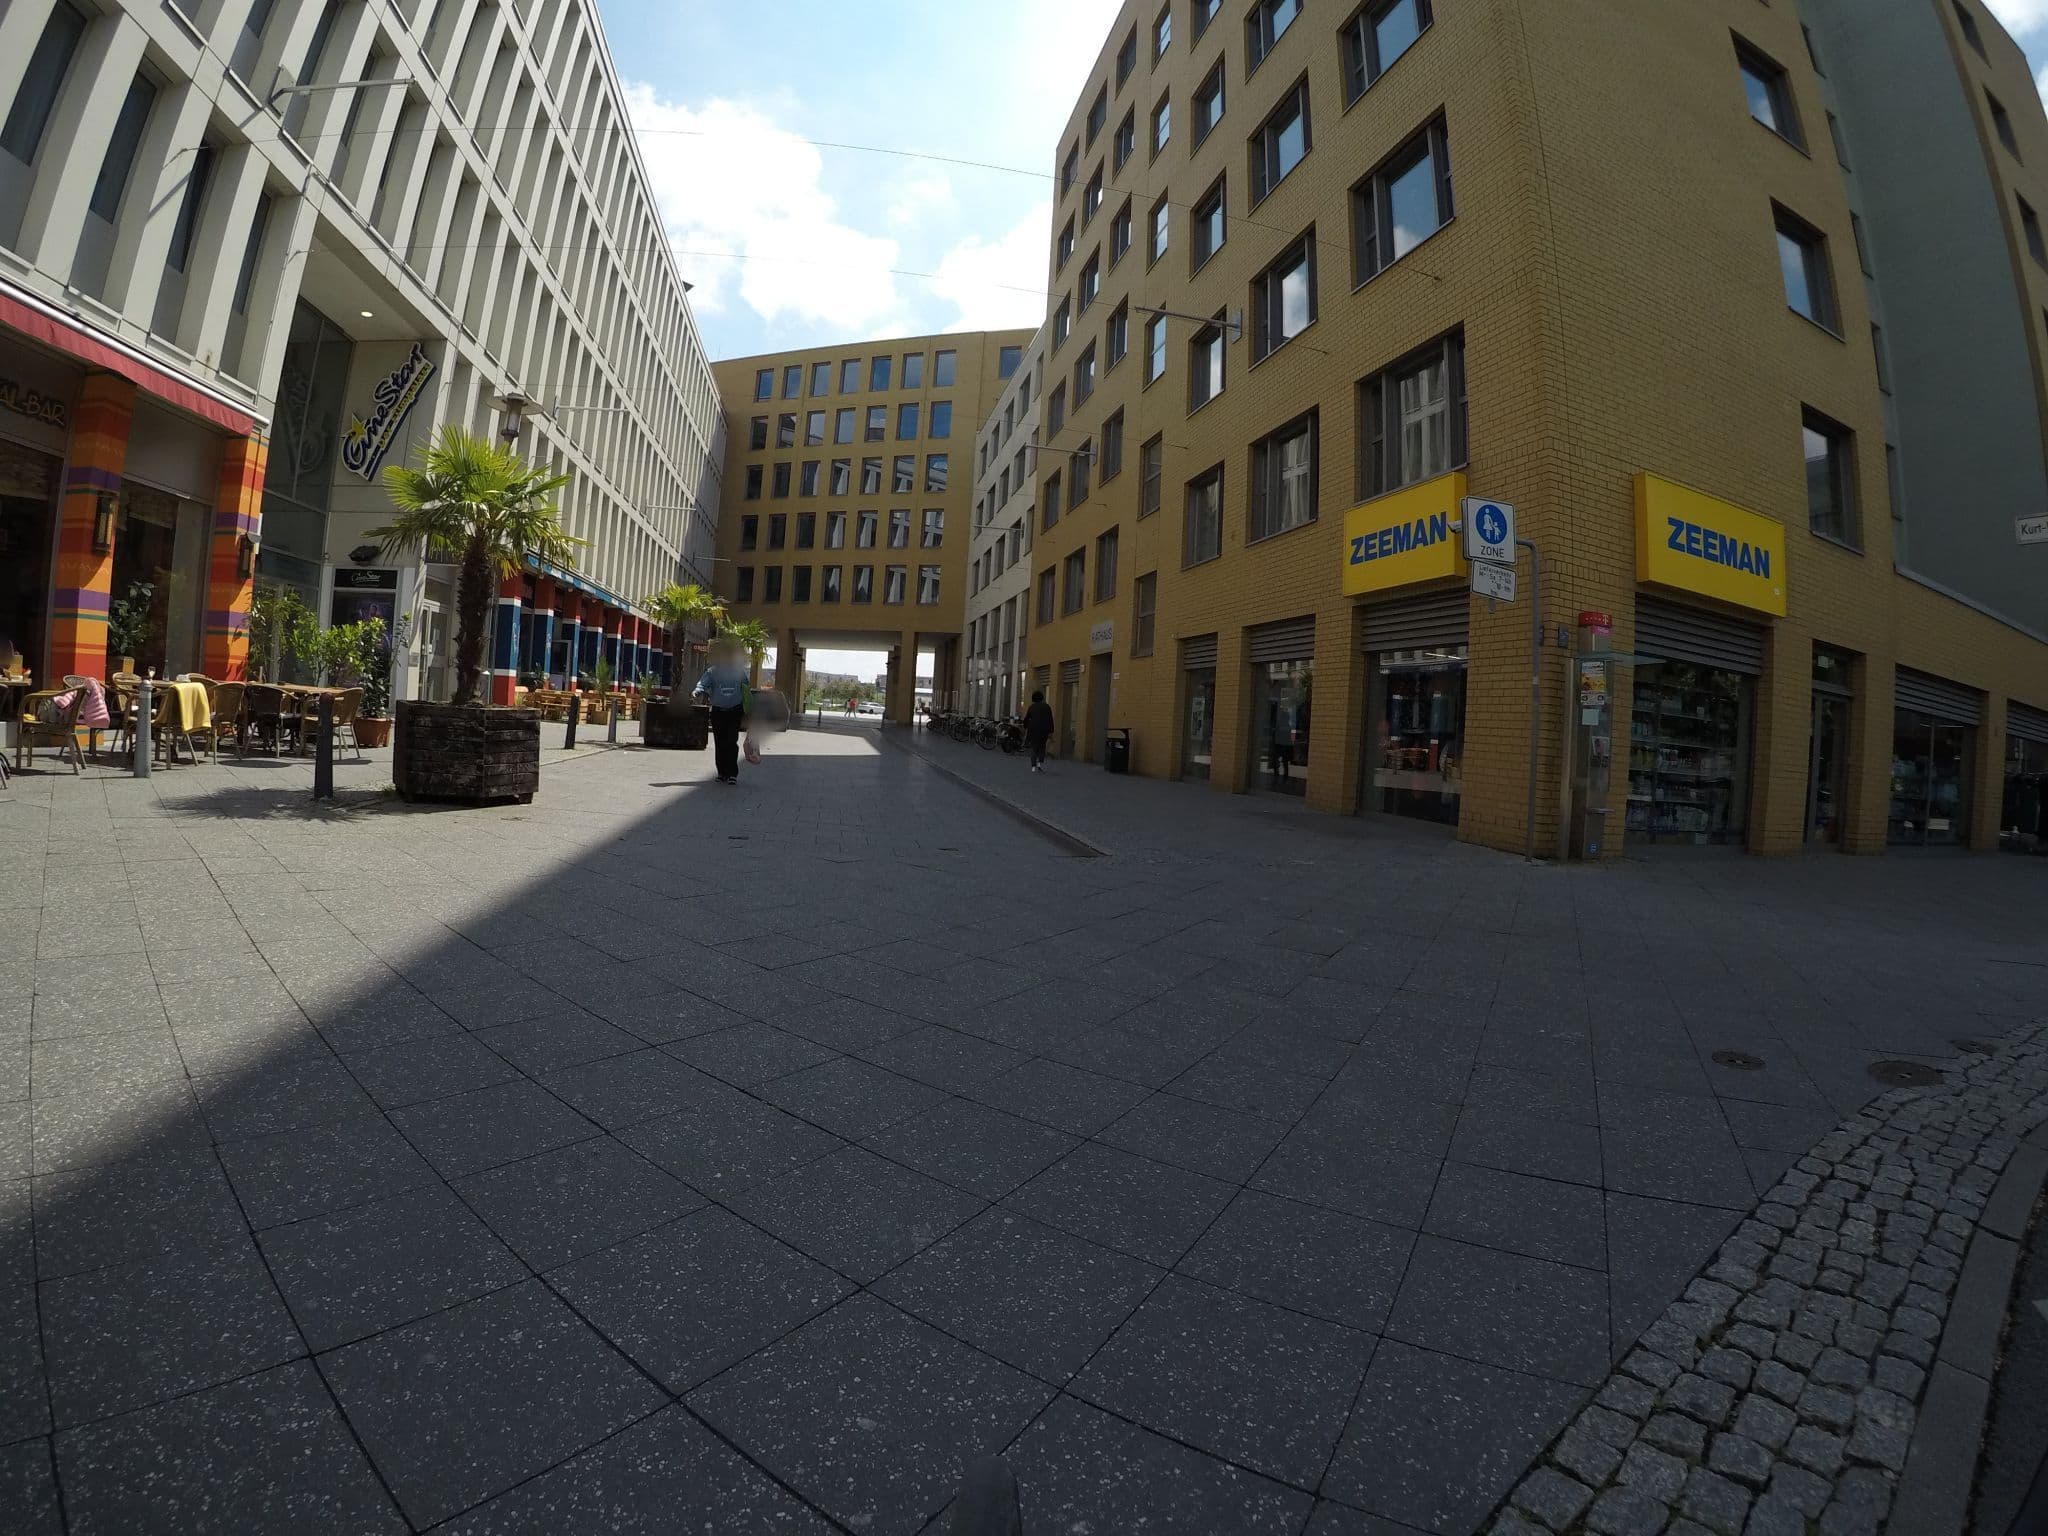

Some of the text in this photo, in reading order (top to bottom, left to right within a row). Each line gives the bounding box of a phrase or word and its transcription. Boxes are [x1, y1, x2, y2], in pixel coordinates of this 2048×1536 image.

[343, 342, 421, 471] CineStar
[1350, 511, 1447, 565] ZEEMAN
[1480, 545, 1505, 558] ZONE
[1667, 516, 1770, 579] ZEEMAN
[2020, 521, 2048, 535] Kurt-
